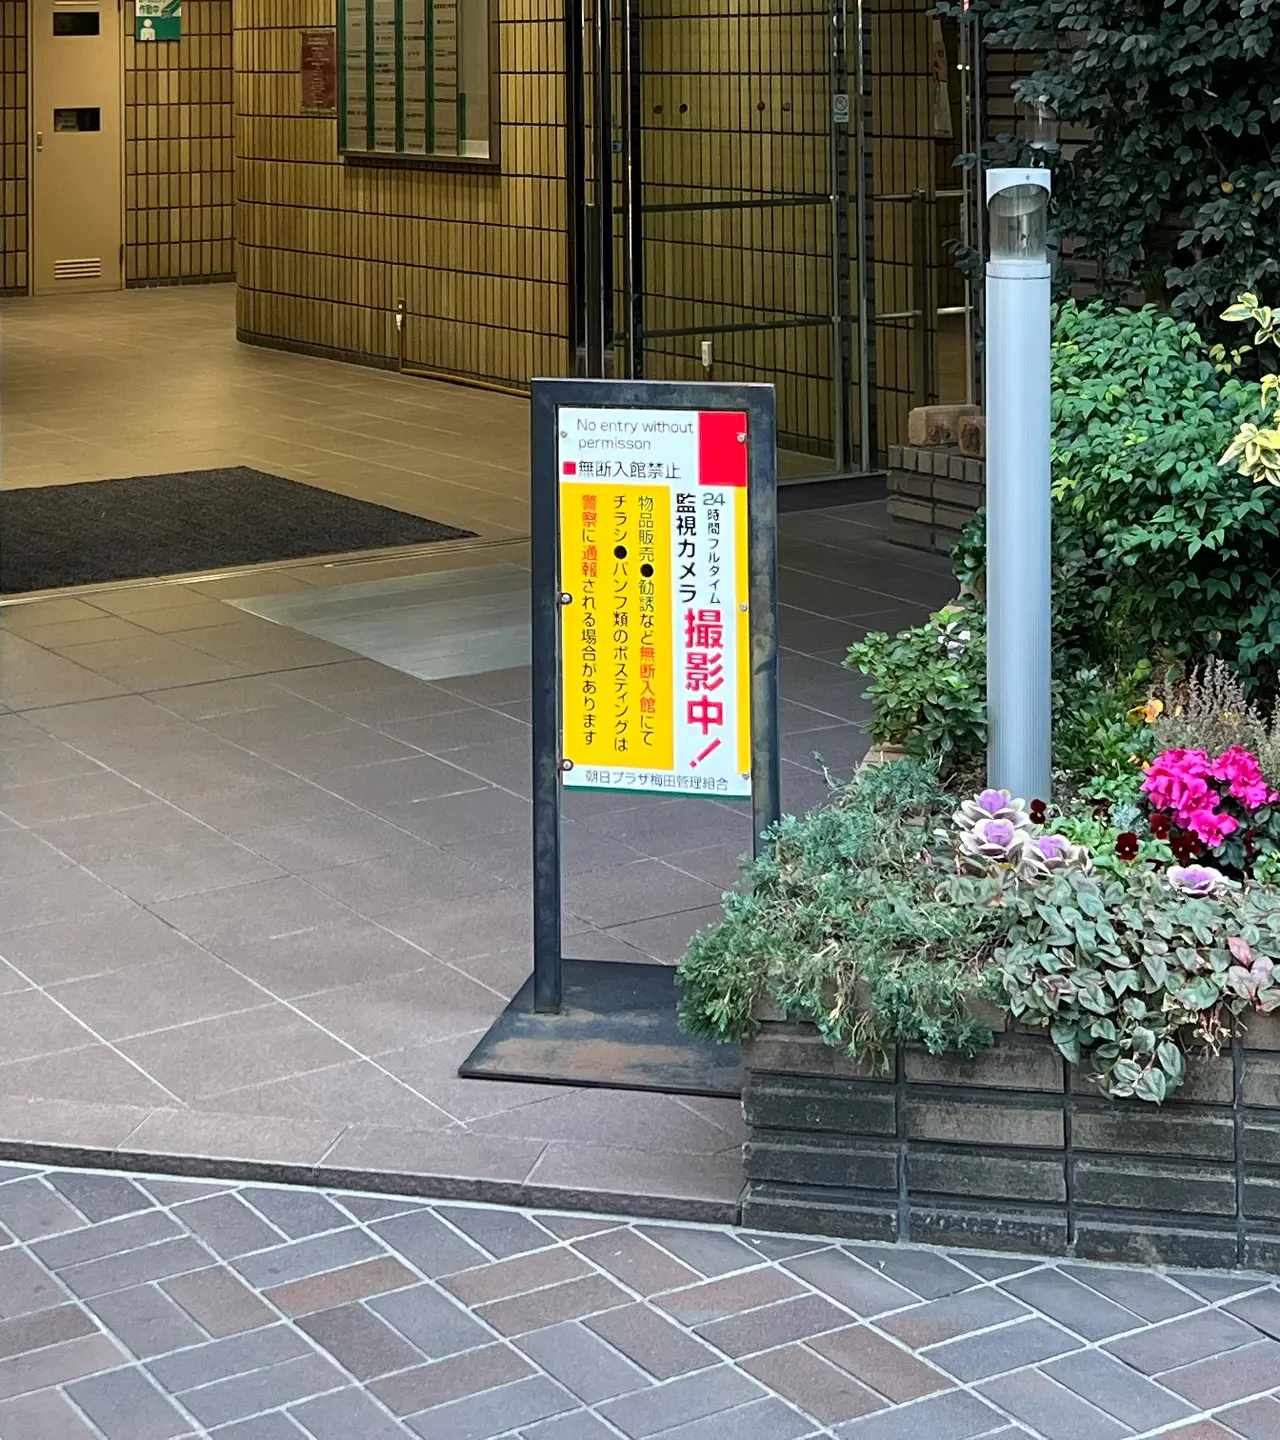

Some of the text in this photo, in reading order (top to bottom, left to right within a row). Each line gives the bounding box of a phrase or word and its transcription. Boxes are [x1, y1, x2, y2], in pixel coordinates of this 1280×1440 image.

[577, 418, 694, 435] No entry without
[578, 437, 651, 451] permisson
[578, 460, 682, 479] 無断入館禁止
[676, 493, 697, 603] 監視カメラ
[581, 494, 598, 746] 警察に通報される場合があります
[684, 608, 725, 769] 撮影中!
[585, 769, 729, 791] 朝日プラザ梅田管理組合
